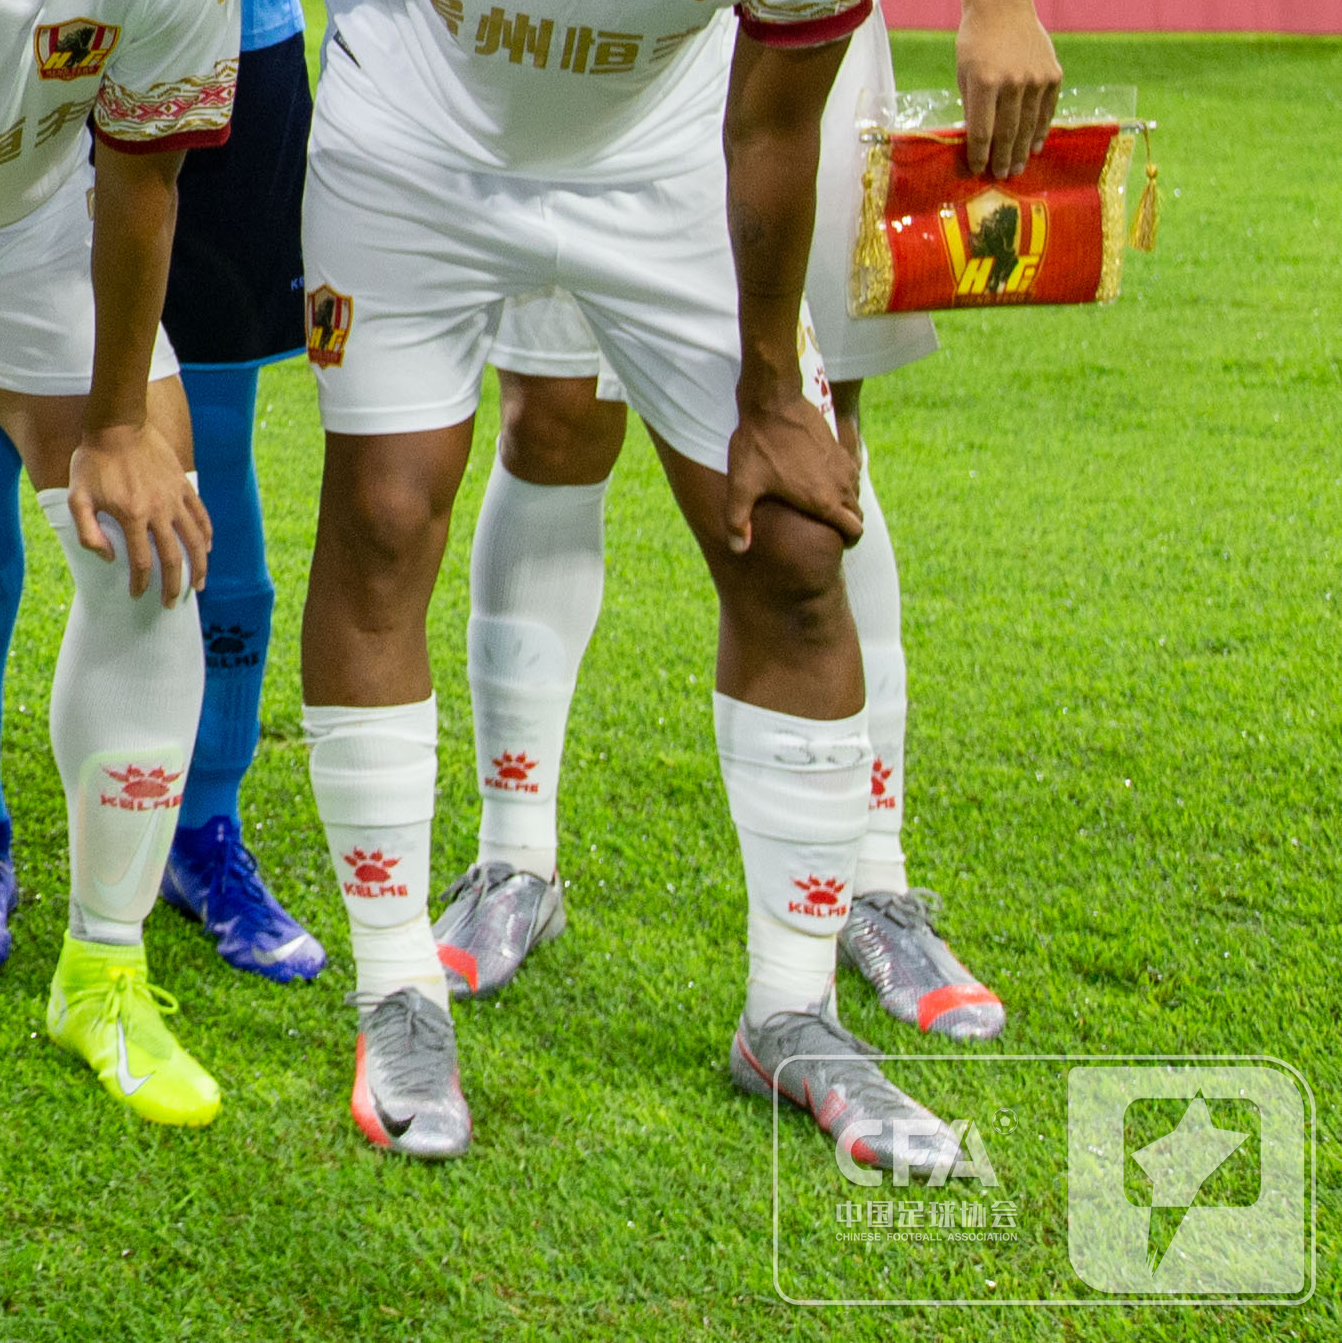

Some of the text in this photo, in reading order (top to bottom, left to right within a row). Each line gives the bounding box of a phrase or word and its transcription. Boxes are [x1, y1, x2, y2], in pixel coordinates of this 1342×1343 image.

[485, 778, 539, 793] KELME
[344, 883, 408, 897] KELME
[788, 901, 847, 918] KELME
